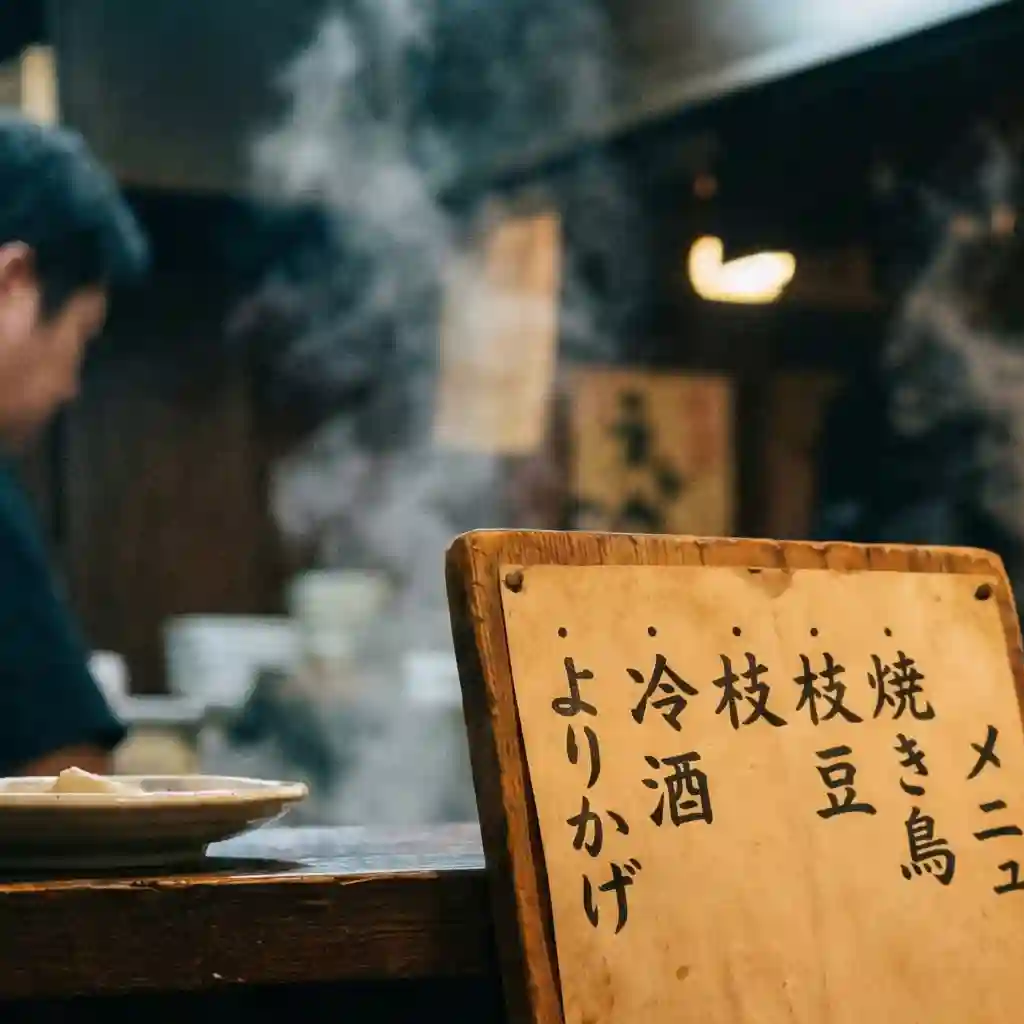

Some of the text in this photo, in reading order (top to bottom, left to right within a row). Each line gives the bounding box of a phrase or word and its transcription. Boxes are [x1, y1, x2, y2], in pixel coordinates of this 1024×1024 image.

[625, 653, 714, 828] 冷酒
[712, 651, 788, 730] 枝
[794, 651, 878, 820] 枝豆
[867, 650, 956, 886] 焼き鳥
[551, 656, 643, 935] よりかげ
